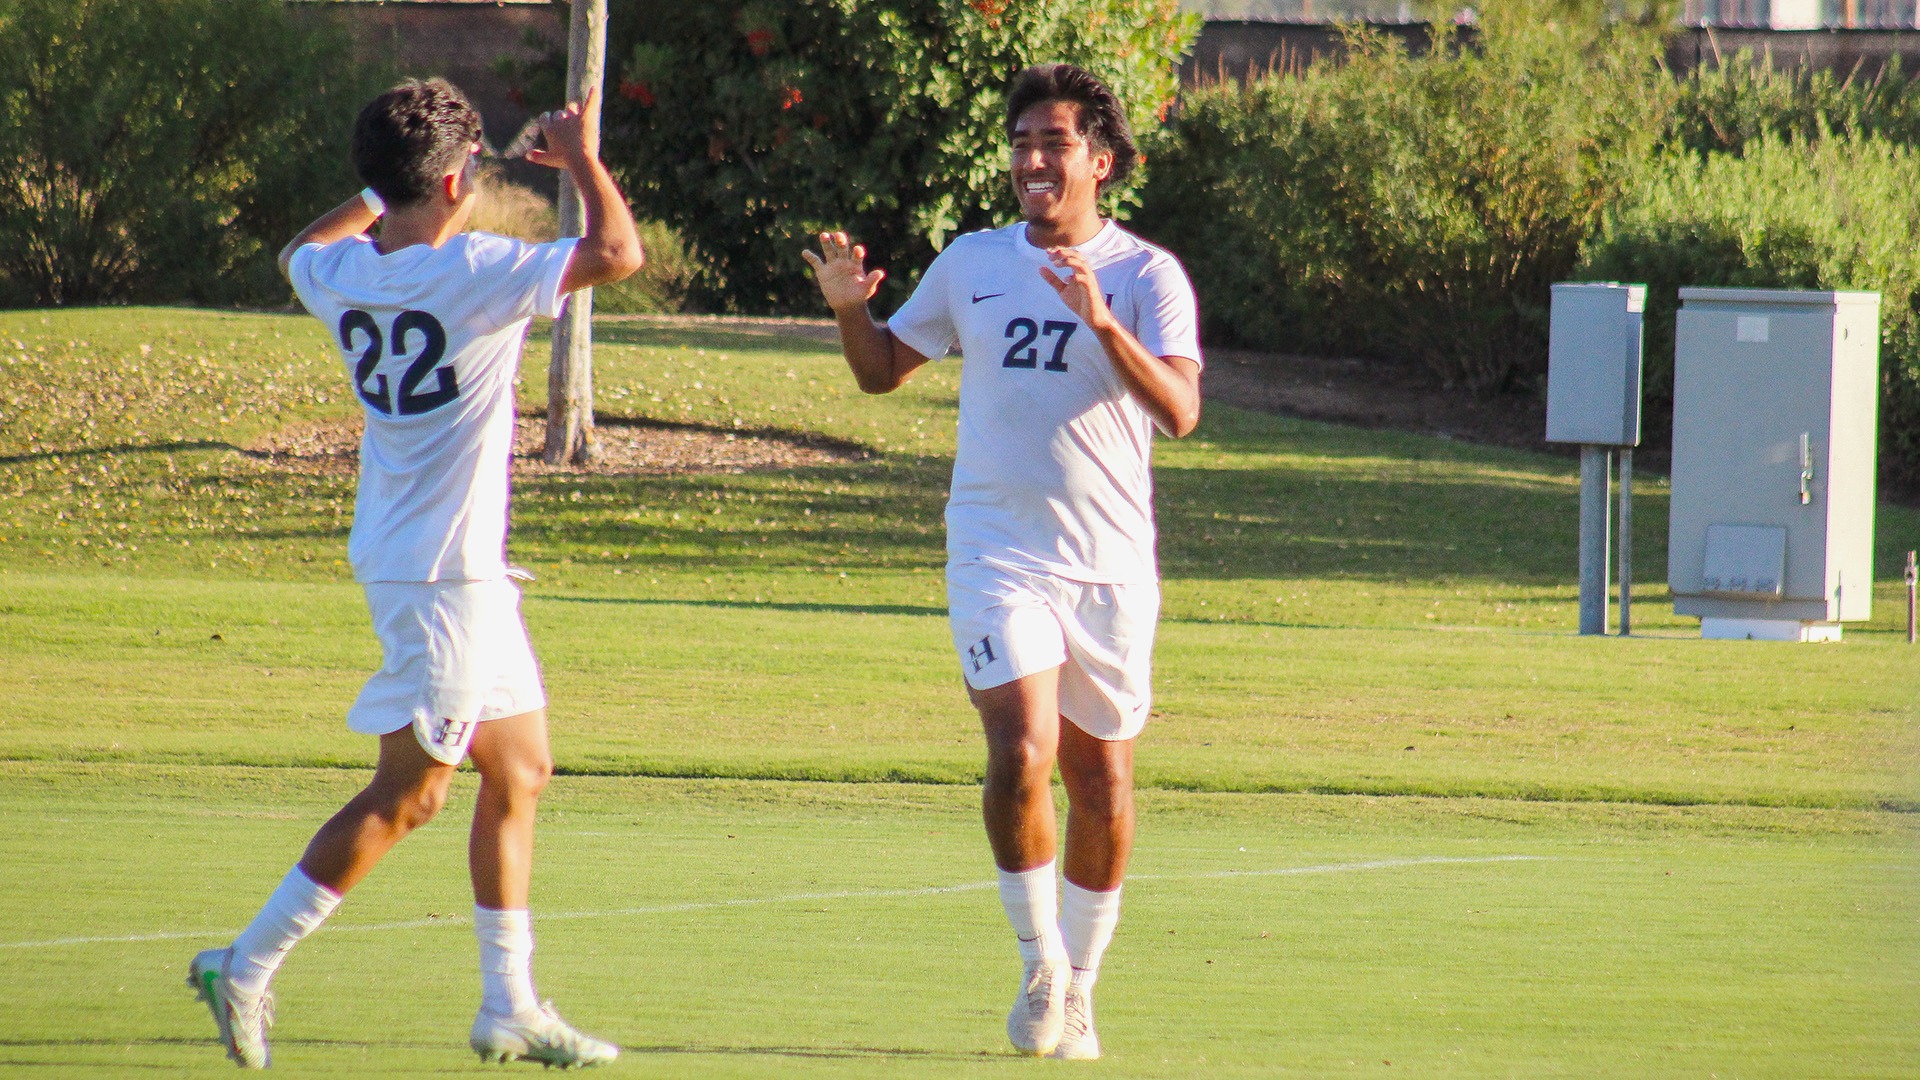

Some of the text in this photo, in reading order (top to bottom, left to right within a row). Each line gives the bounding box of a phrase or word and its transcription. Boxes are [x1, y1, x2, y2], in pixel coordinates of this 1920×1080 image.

[339, 309, 460, 415] 22
[1002, 317, 1078, 372] 27
[968, 634, 998, 674] H
[433, 717, 471, 747] H
